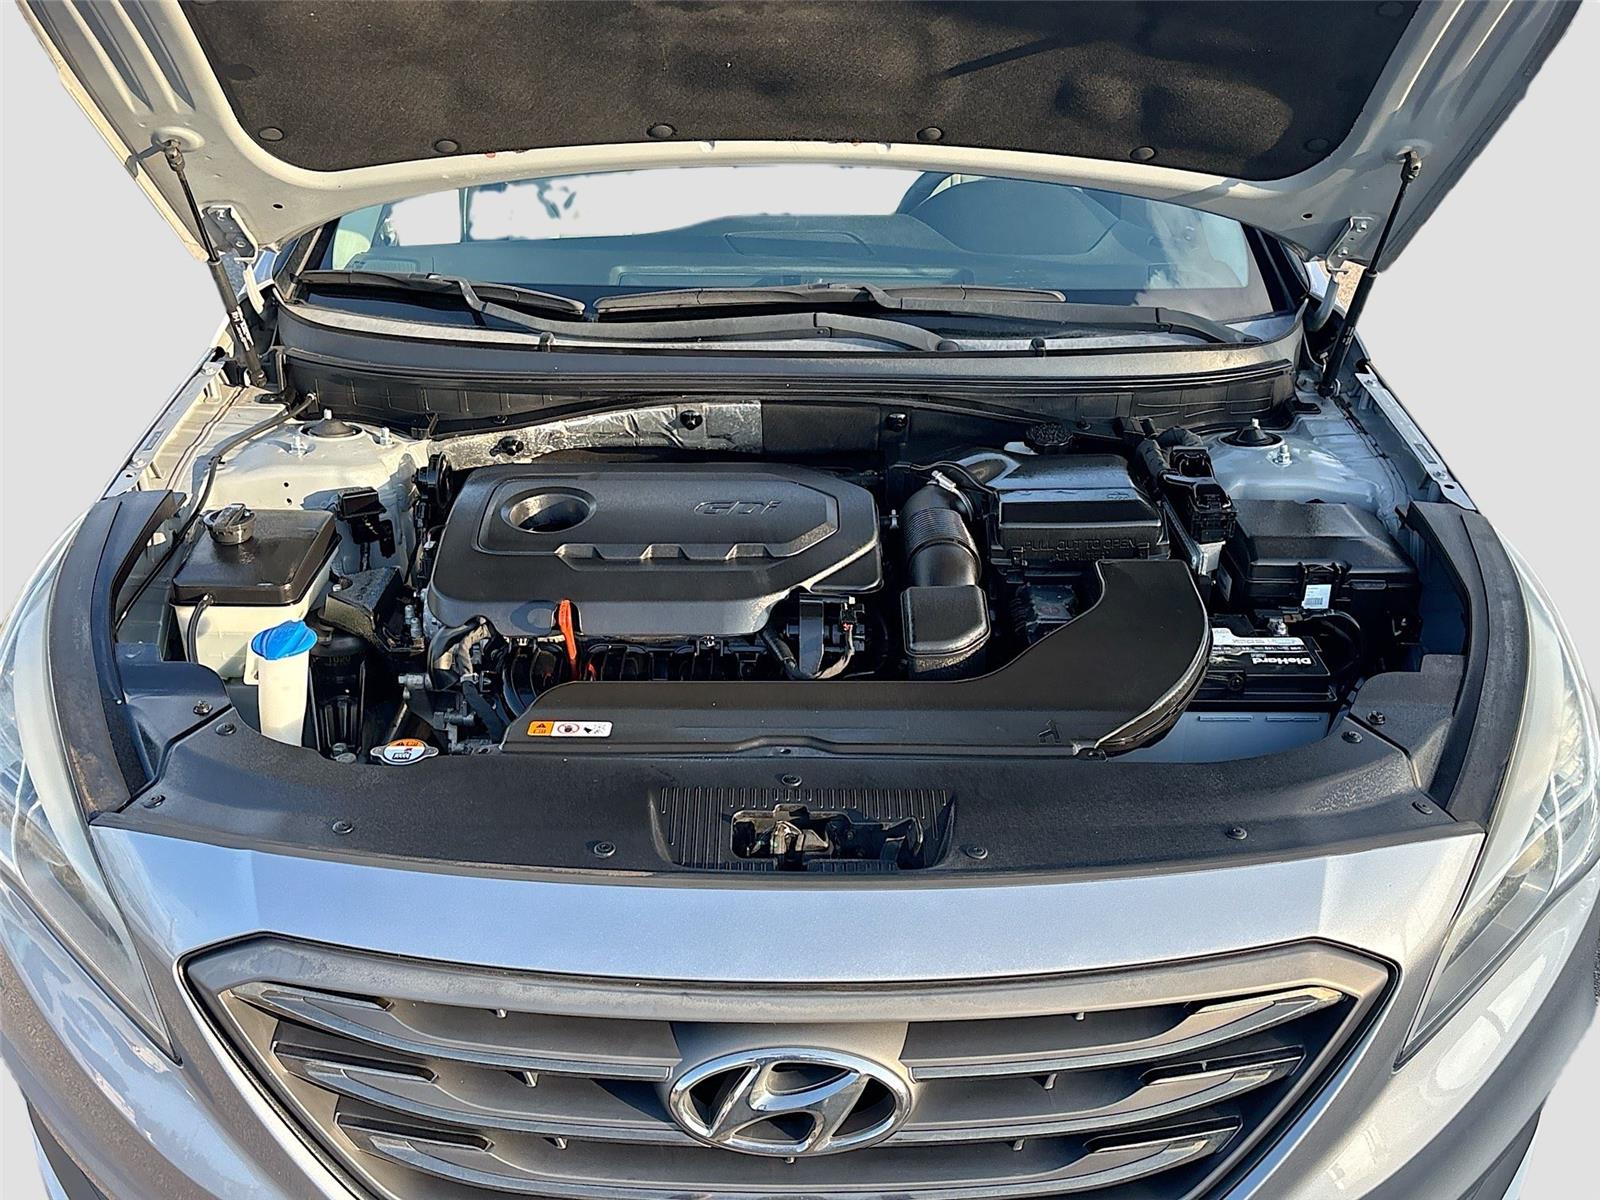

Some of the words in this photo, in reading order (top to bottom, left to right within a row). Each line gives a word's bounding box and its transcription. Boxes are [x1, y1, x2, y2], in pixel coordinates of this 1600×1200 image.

[1023, 539, 1054, 551] PULL
[1056, 540, 1082, 551] OUT
[1084, 539, 1100, 550] TO
[1103, 538, 1136, 549] OPEN
[1252, 656, 1313, 665] DieHard
